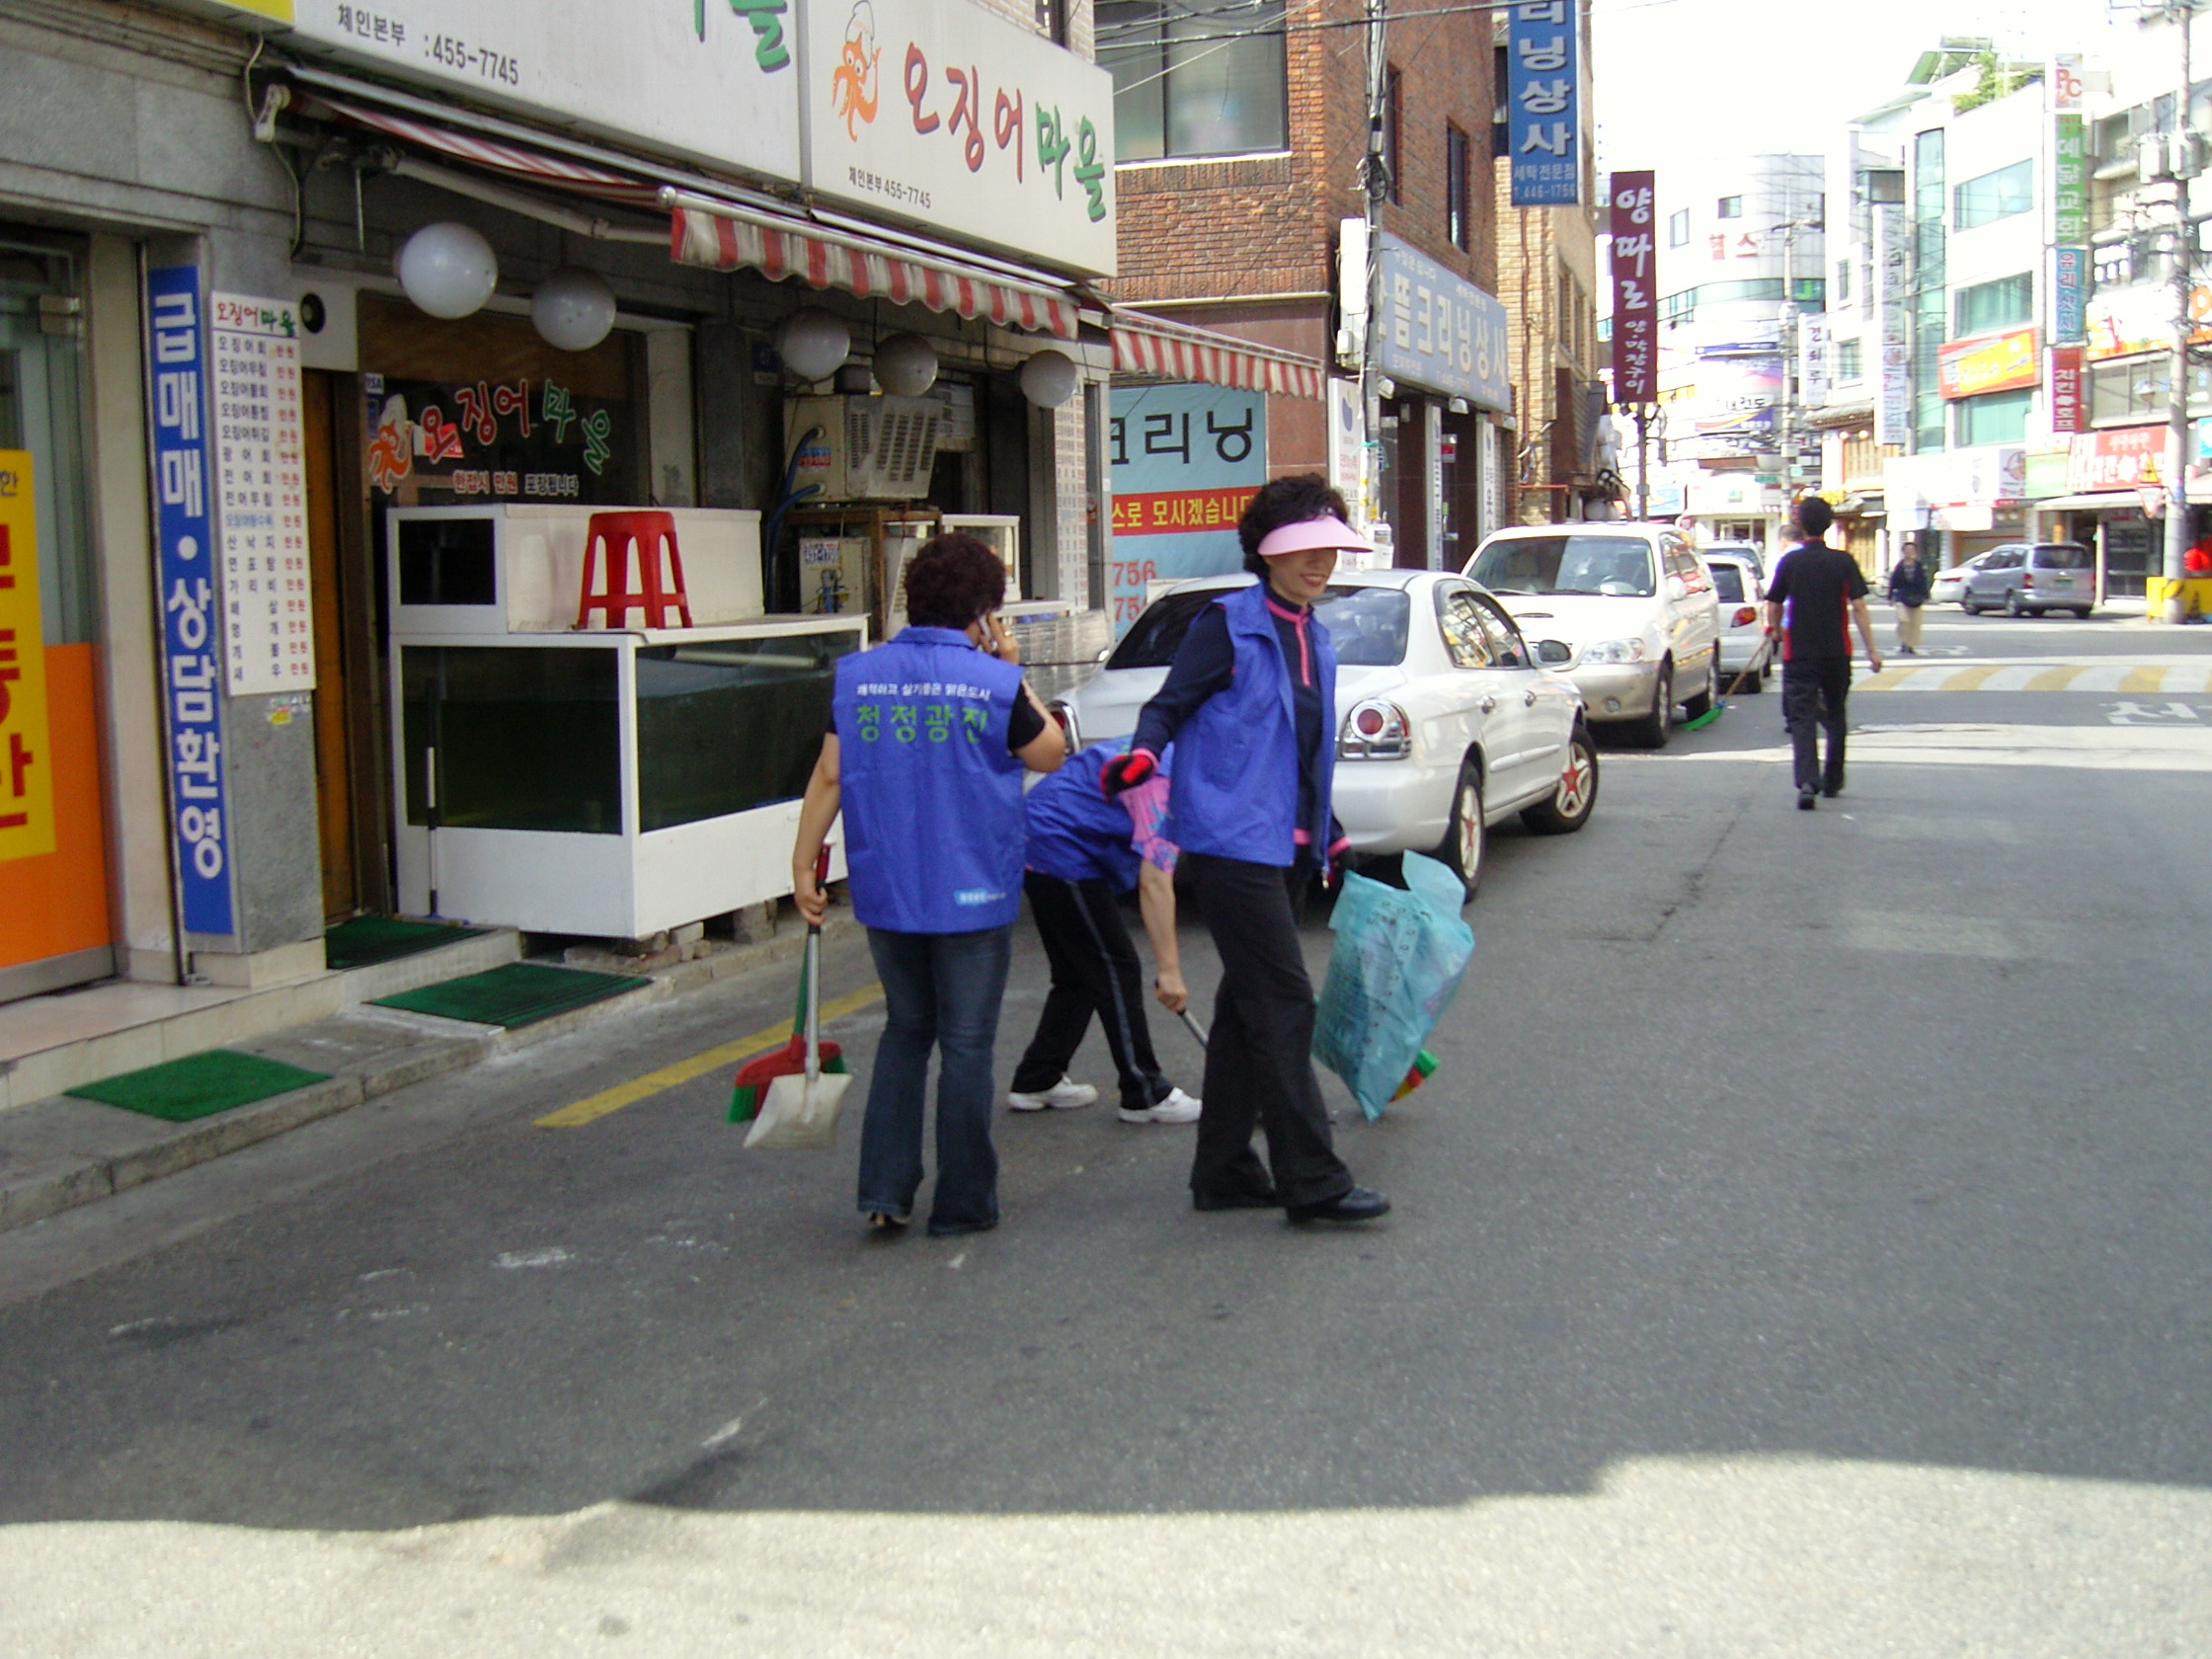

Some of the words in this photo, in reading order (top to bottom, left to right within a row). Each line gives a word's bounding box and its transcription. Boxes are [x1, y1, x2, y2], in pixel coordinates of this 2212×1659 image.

[338, 2, 406, 47] 체인본부
[848, 166, 883, 194] 체인본부
[884, 179, 931, 209] 455-7745
[1709, 233, 1759, 261] 헬스
[494, 470, 518, 494] 만원
[524, 473, 581, 497] 포장됩니다
[167, 577, 223, 880] 상담환영
[855, 703, 989, 744] 청정광진
